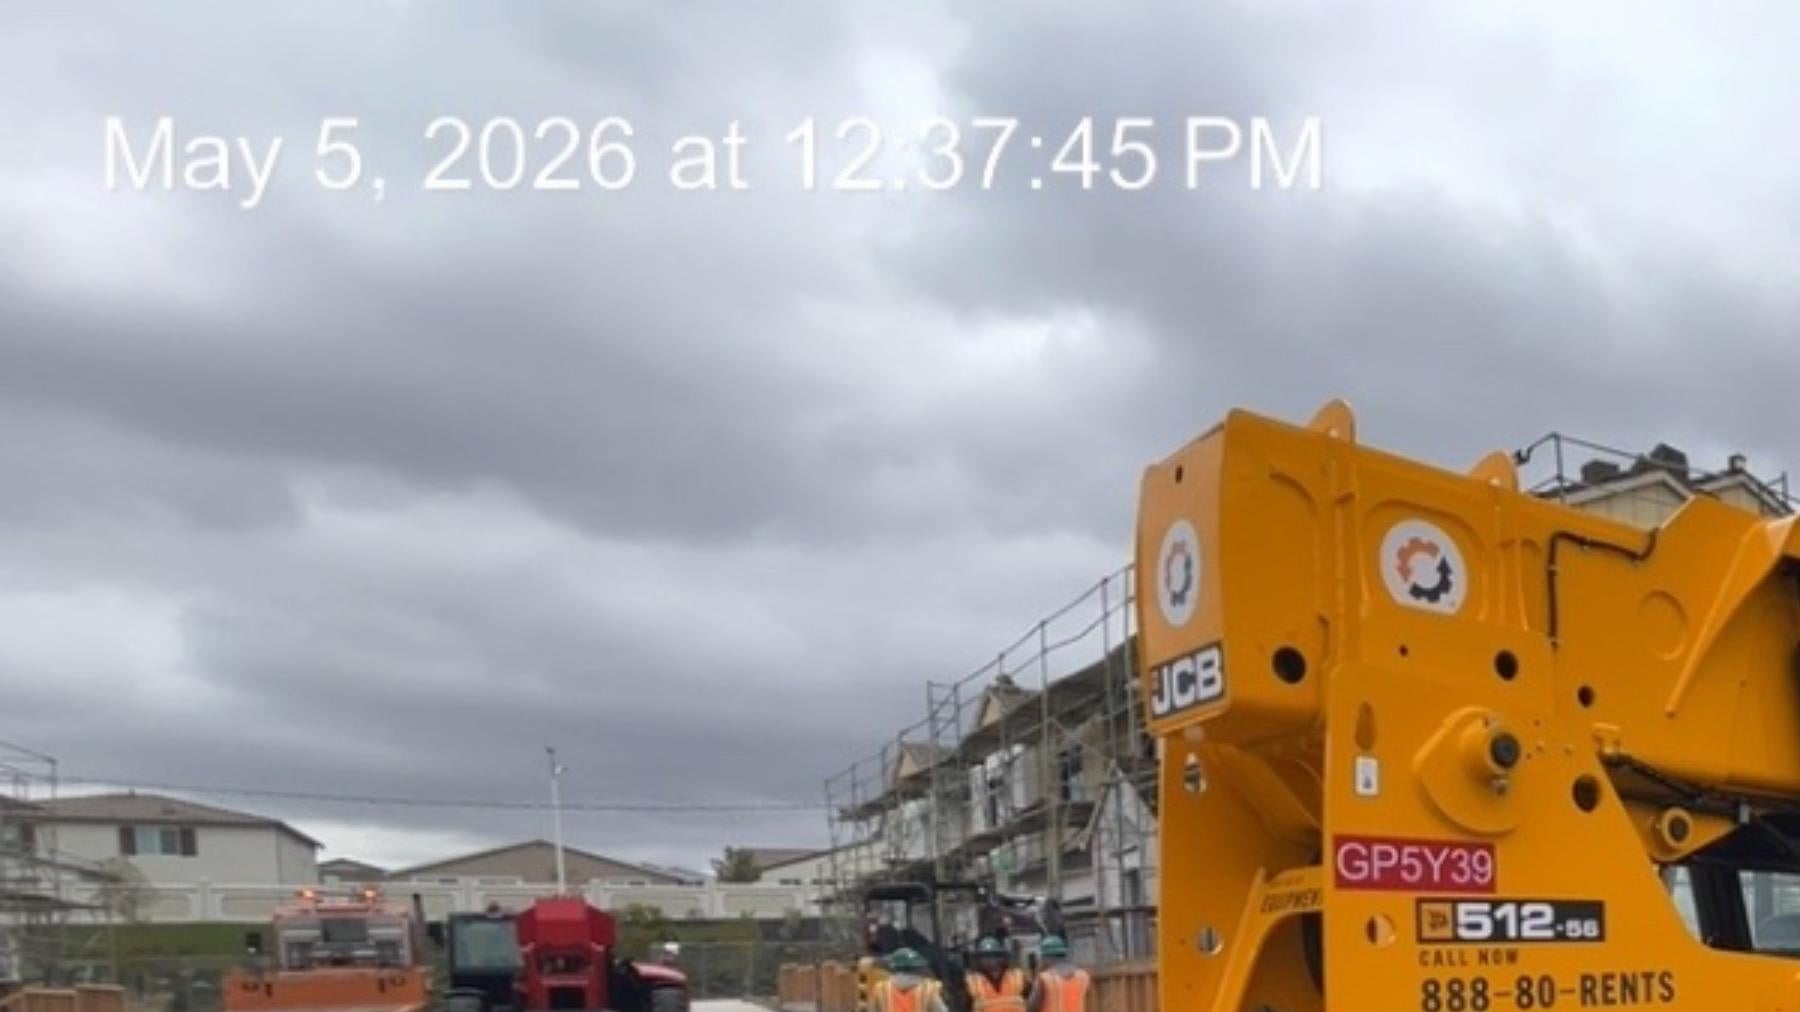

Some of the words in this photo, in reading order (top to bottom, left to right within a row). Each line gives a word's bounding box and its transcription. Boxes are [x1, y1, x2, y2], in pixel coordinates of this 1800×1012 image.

[1151, 647, 1222, 715] JCB
[1337, 842, 1494, 885] GP5Y39
[1419, 950, 1468, 967] CALL
[1479, 948, 1519, 965] NOW
